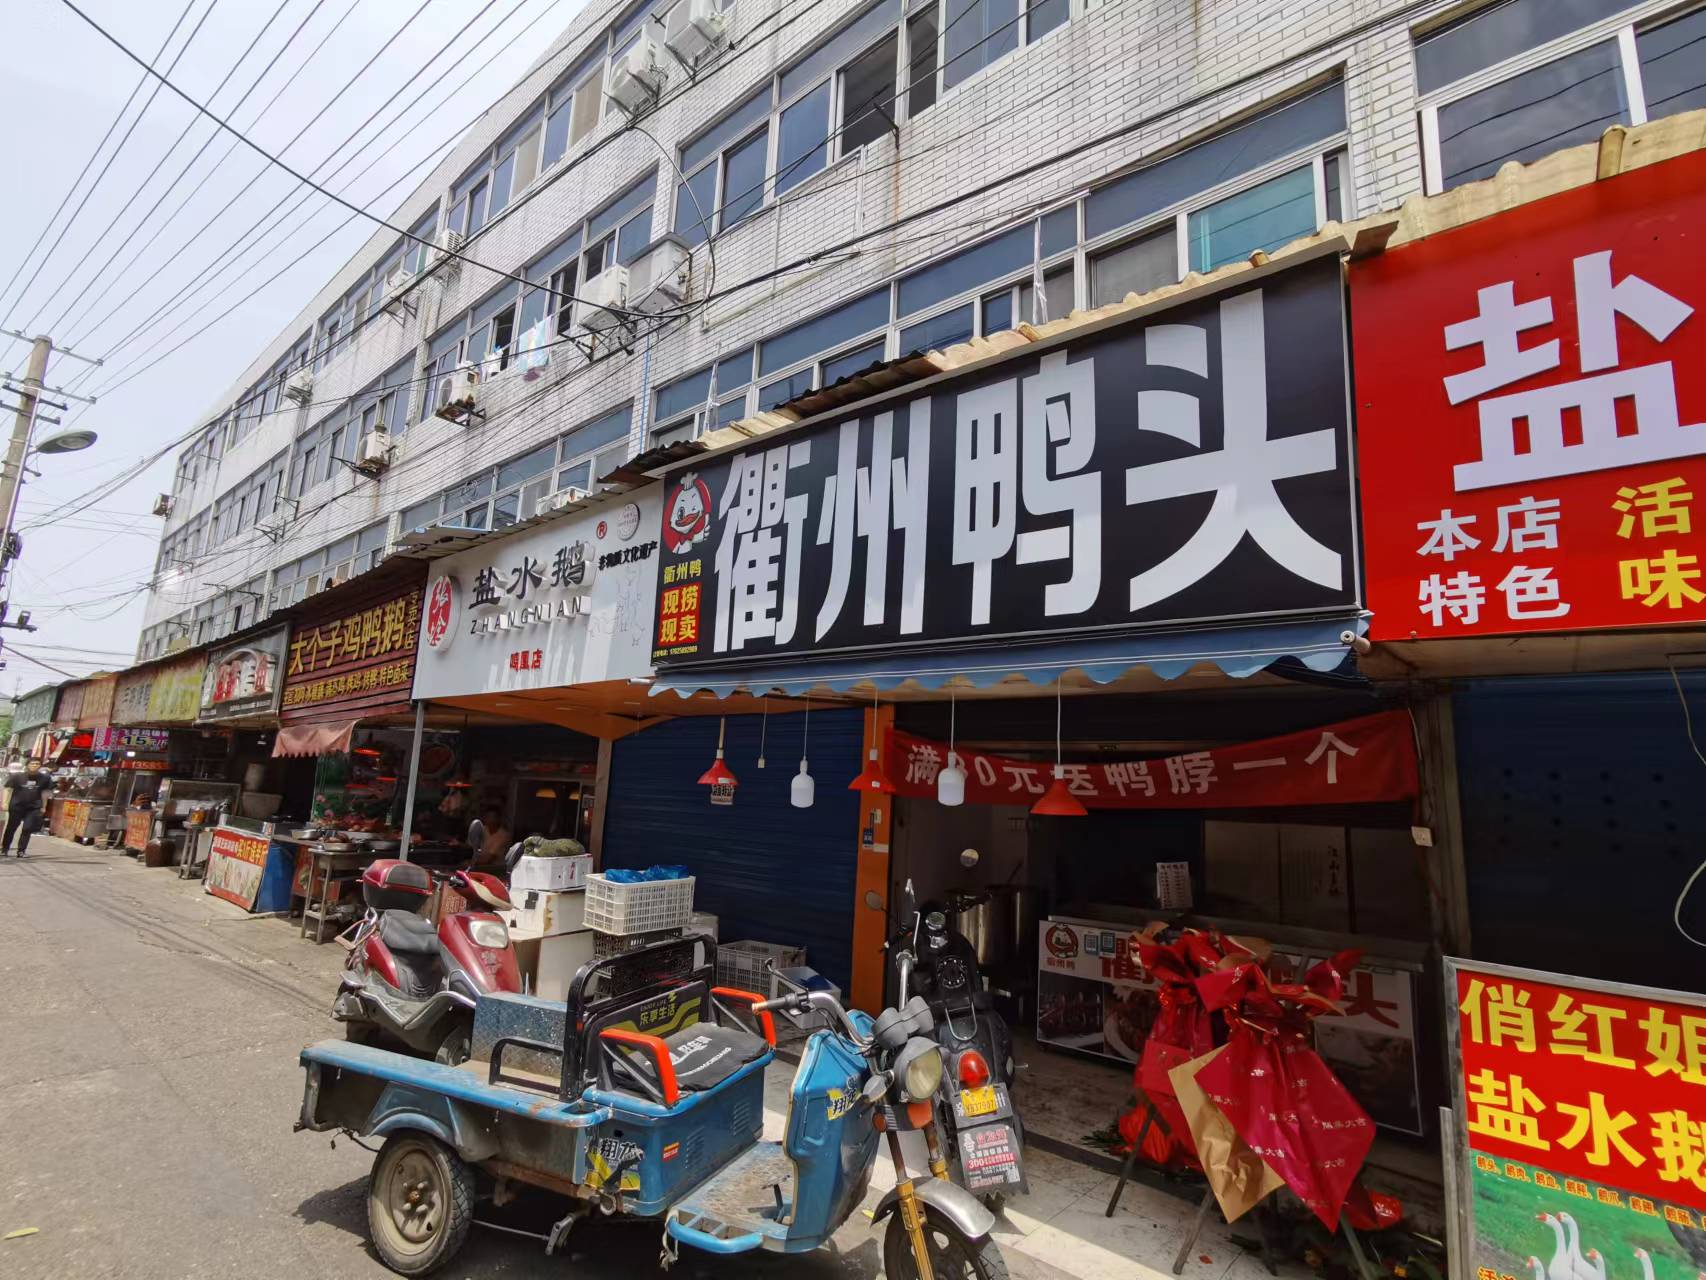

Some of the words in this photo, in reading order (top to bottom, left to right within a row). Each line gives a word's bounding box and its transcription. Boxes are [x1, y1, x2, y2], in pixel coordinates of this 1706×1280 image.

[1443, 250, 1706, 492] 盐
[714, 288, 1343, 653] 衢州鸭头
[1417, 496, 1561, 561] 本店
[1611, 477, 1693, 539] 活
[469, 540, 586, 609] 盐水鹅
[663, 585, 698, 614] 现捞
[664, 559, 702, 584] 衢州鸭
[1418, 565, 1571, 627] 特色
[1619, 549, 1706, 608] 味
[288, 597, 405, 677] 大个子鸡鸭鹅
[660, 616, 696, 643] 现卖
[1459, 979, 1706, 1086] 俏红姐
